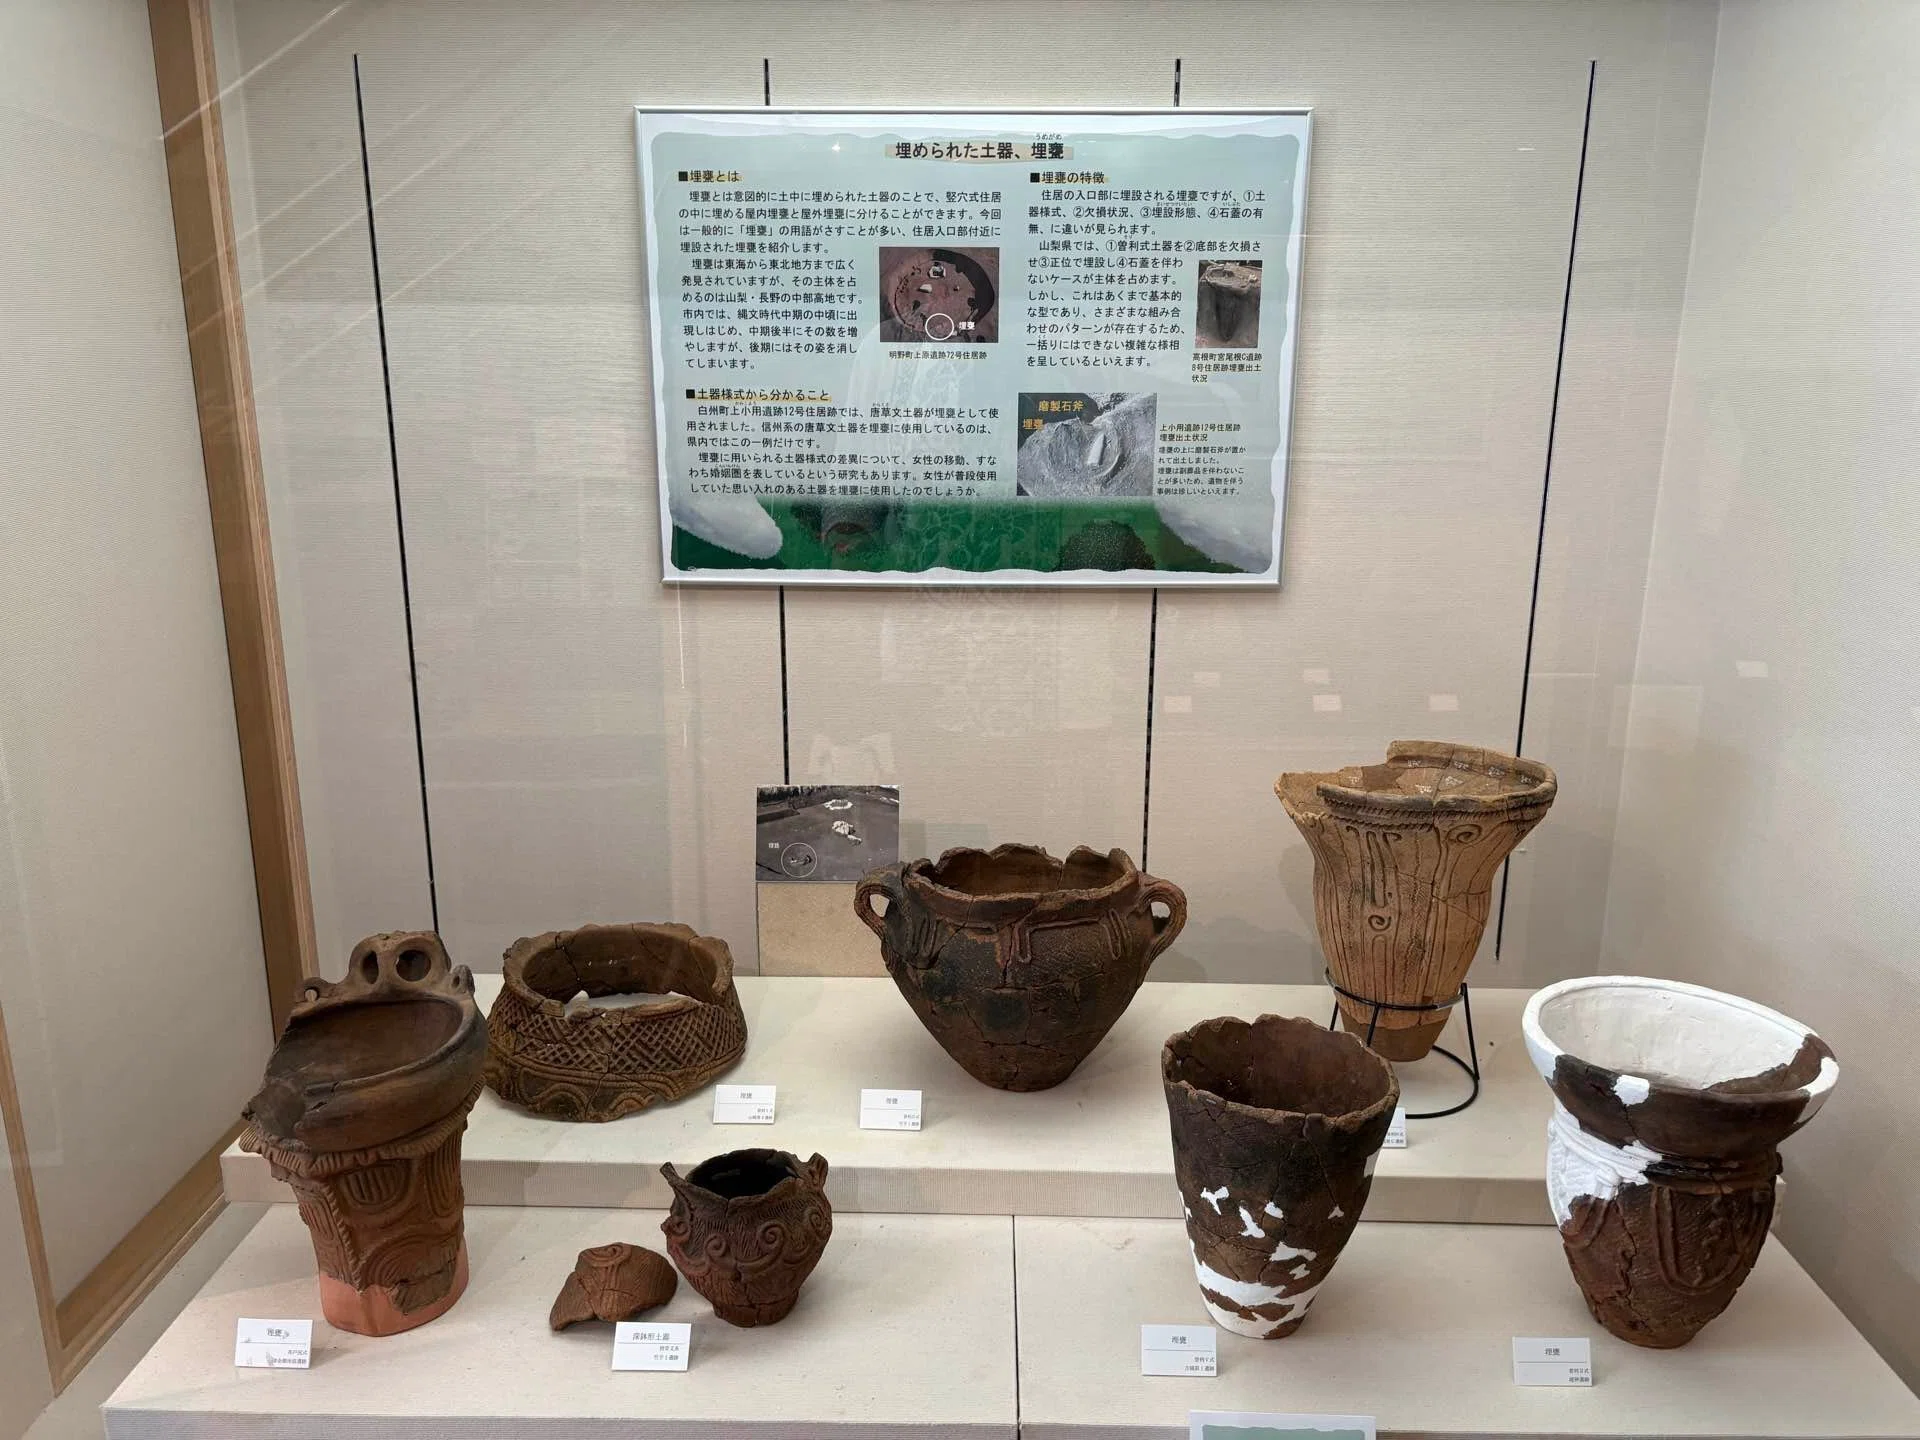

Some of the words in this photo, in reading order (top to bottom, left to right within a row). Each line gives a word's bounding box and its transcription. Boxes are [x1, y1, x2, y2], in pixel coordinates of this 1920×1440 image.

[895, 142, 1065, 160] 埋められた土器、埋甕
[690, 170, 740, 183] 埋甕とは
[1041, 172, 1105, 184] 埋甕の特徴
[1028, 223, 1156, 235] 無、に違いが見られます。
[680, 241, 829, 254] 埋設された埋甕を紹介します。
[691, 259, 856, 271] 埋甕は東海から東北地方まで広く
[681, 275, 857, 288] 発見されていますが、その主体を占
[1027, 273, 1177, 285] ないケースが主体を占めます。
[1028, 289, 1182, 302] しかし、これはあくまで基本的
[1027, 306, 1181, 319] な型であり、さまざまな組み合
[683, 325, 858, 338] 現しはじめ、中期後半にその数を増
[1026, 322, 1185, 335] わせのパターンが存在するため、
[684, 342, 858, 354] やしますが、後期にはその姿を消し
[1026, 339, 1180, 351] 一括りにはできない複雑な様相
[685, 358, 757, 370] てしまいます。
[1027, 355, 1151, 367] を呈しているといえます。
[1191, 374, 1208, 383] 状況
[697, 388, 831, 401] 土器様式から分かること
[687, 436, 821, 449] 県内ではこの一例だけです。
